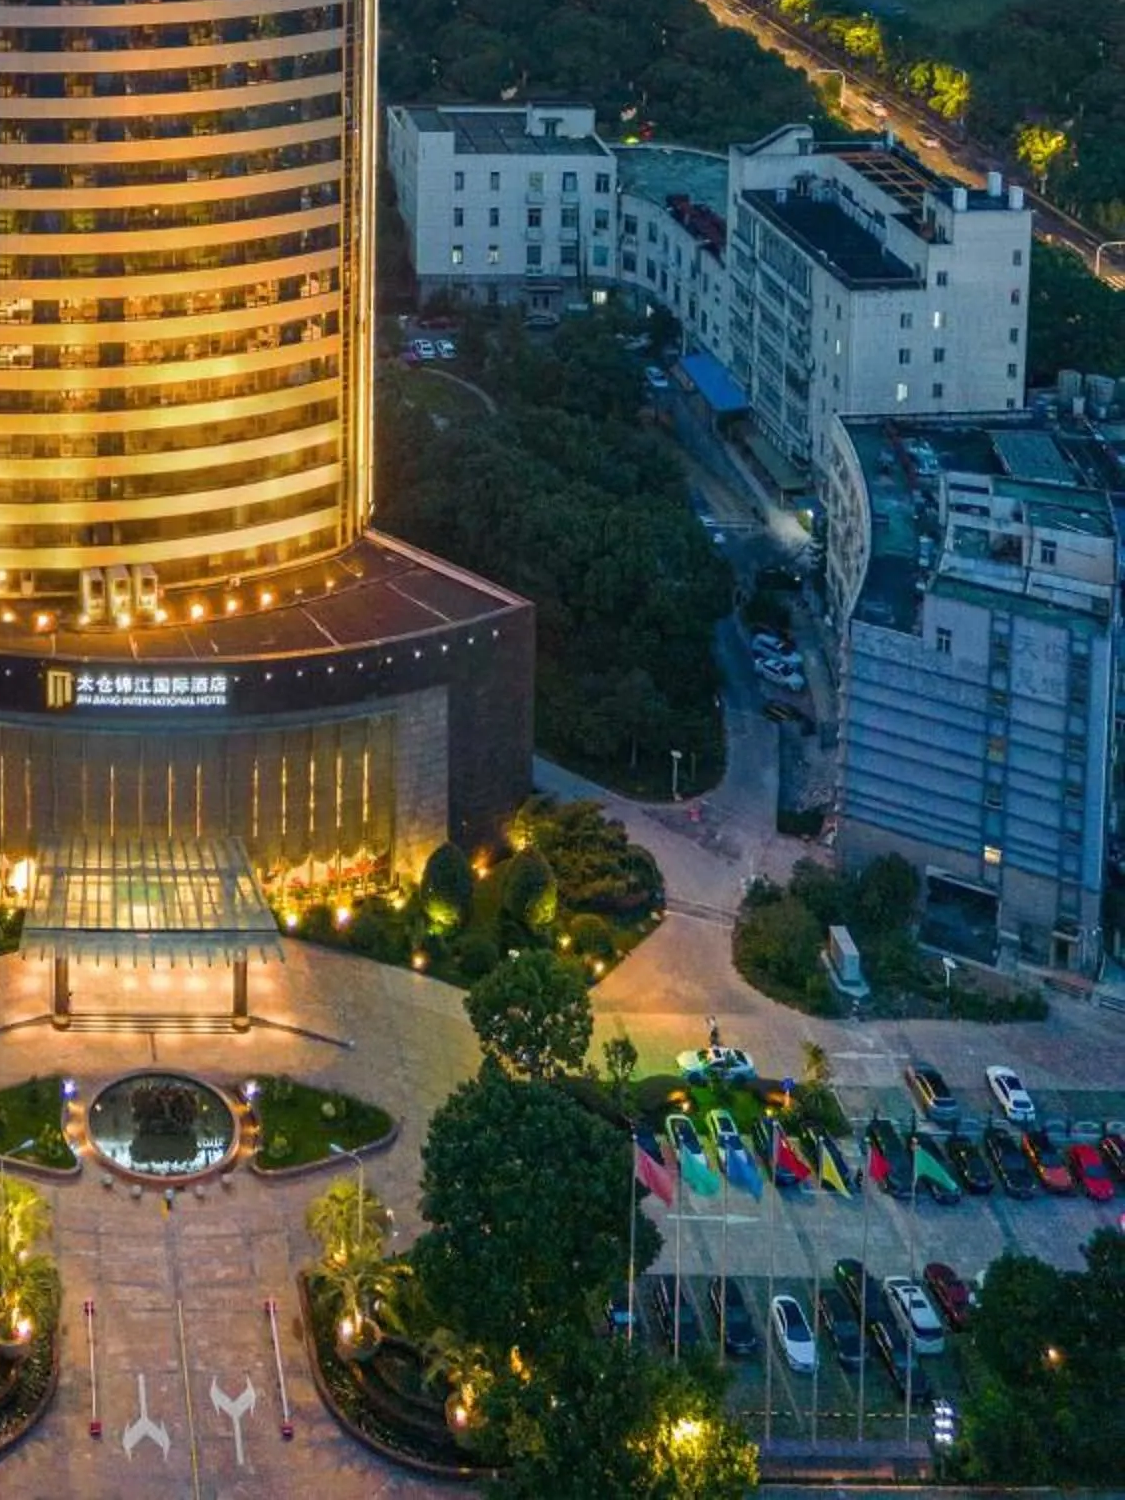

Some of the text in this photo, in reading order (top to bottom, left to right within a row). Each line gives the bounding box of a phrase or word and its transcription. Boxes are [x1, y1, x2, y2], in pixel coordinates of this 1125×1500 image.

[76, 675, 227, 693] 太仓锦江国际酒店
